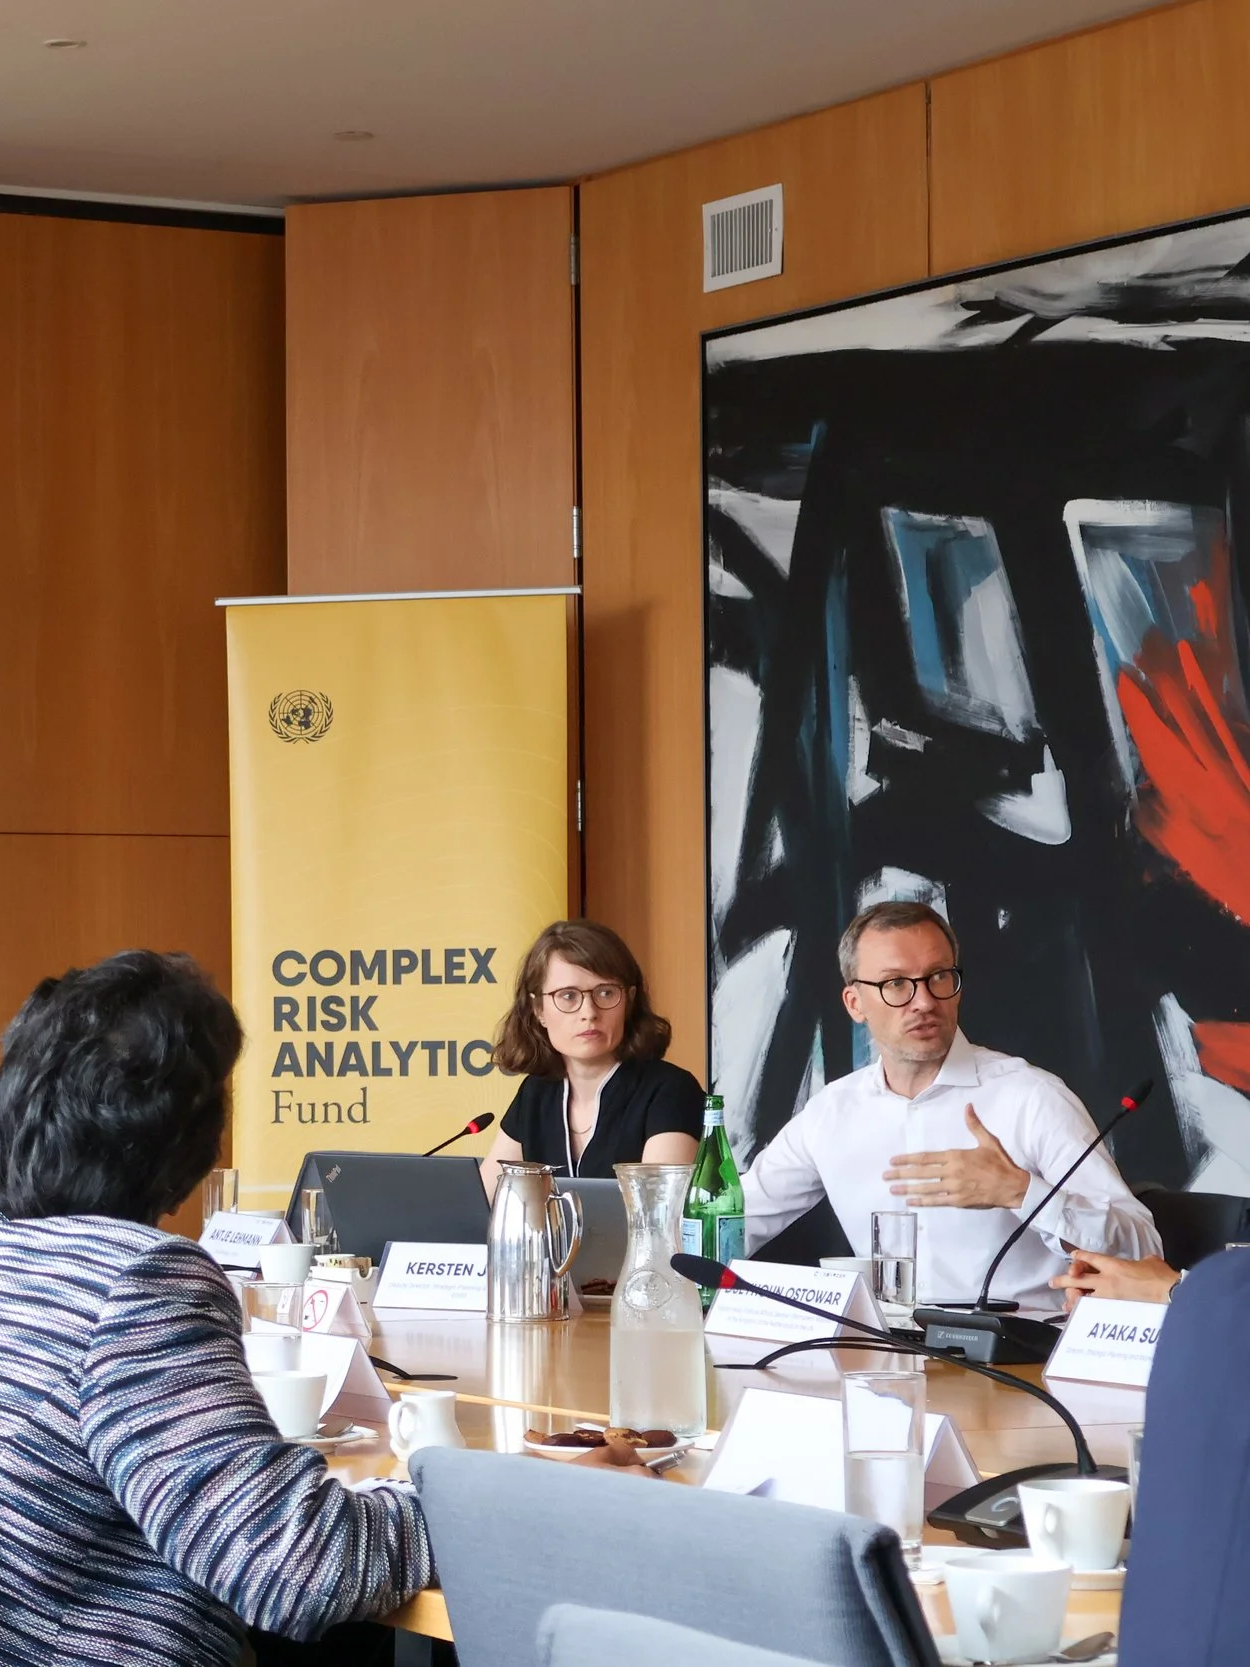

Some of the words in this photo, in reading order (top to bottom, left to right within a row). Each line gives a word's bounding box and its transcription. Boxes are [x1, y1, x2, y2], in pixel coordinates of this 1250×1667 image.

[272, 947, 498, 987] COMPLEX
[273, 995, 379, 1032] RISK
[271, 1039, 521, 1078] ANALYTIC
[271, 1086, 370, 1124] Fund
[209, 1228, 231, 1243] ANTJE
[230, 1231, 263, 1246] LEHMANN
[406, 1262, 474, 1277] KERSTEN
[785, 1287, 842, 1306] OSTOWAR
[1087, 1322, 1138, 1343] AYAKA
[1139, 1327, 1161, 1344] SU
